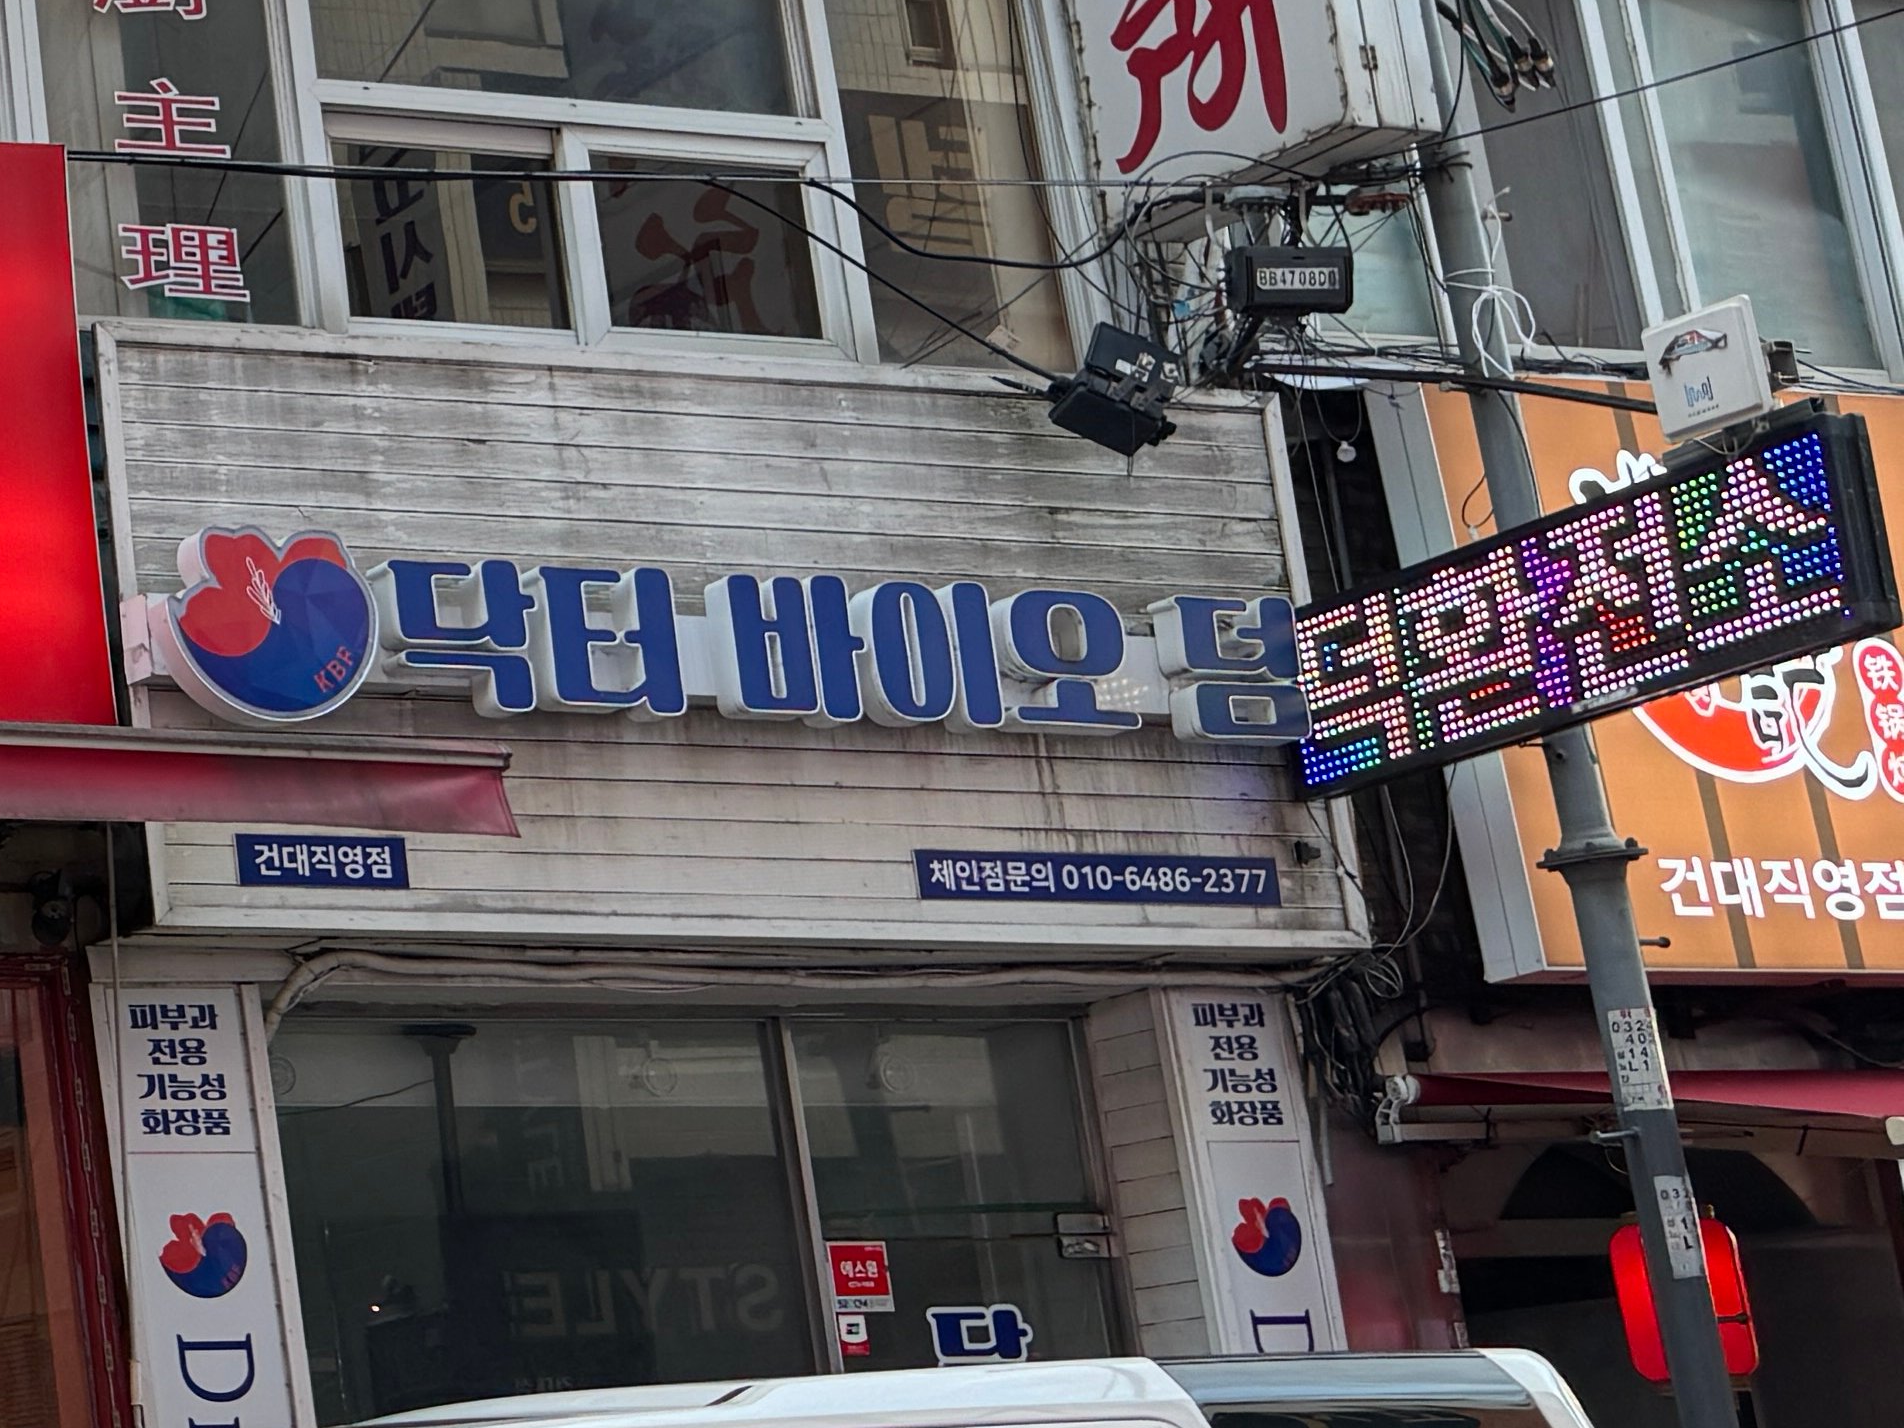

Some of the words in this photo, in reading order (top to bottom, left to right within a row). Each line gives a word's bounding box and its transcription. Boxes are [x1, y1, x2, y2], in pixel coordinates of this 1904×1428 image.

[372, 557, 688, 718] 닥터
[252, 840, 394, 884] 건대직영점
[927, 856, 1056, 896] 체인점문의
[1060, 863, 1268, 901] 010-6486-2377
[1657, 855, 1904, 921] 건대직영점
[127, 1002, 219, 1033] 피부과
[1191, 1002, 1266, 1030] 피부과
[146, 1036, 210, 1067] 전용
[1208, 1034, 1260, 1064] 전용
[136, 1073, 228, 1103] 기능성
[1202, 1066, 1278, 1096] 기능성
[139, 1107, 232, 1138] 화장품
[1208, 1098, 1285, 1129] 화장품
